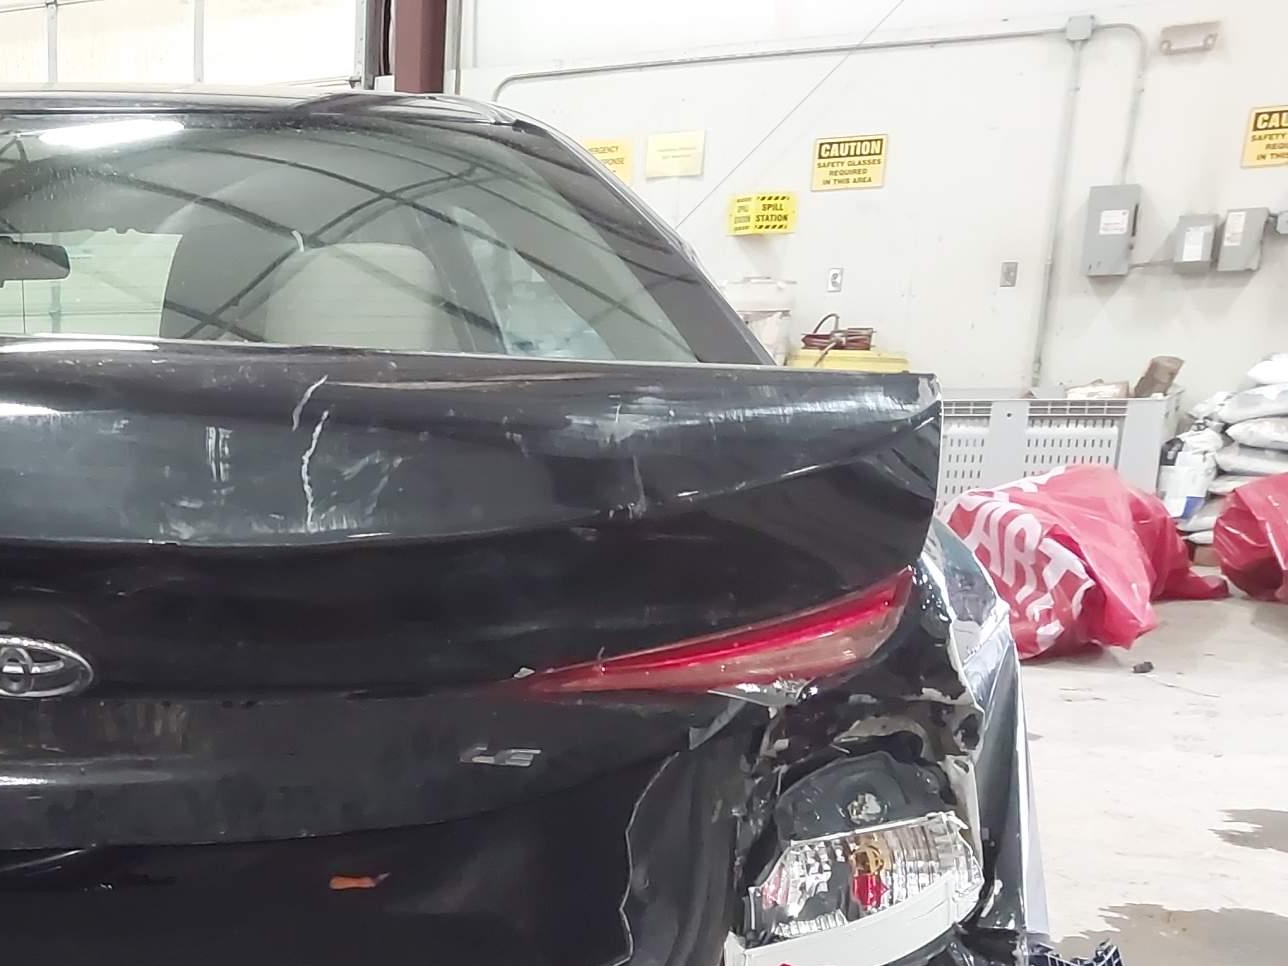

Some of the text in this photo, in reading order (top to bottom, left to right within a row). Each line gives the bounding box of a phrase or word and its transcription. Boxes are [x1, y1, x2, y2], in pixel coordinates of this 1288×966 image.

[820, 140, 881, 158] CAUTION
[847, 159, 881, 167] GLASSES
[828, 168, 868, 176] REQUIRED
[761, 203, 784, 212] SPILL
[755, 214, 788, 222] STATION
